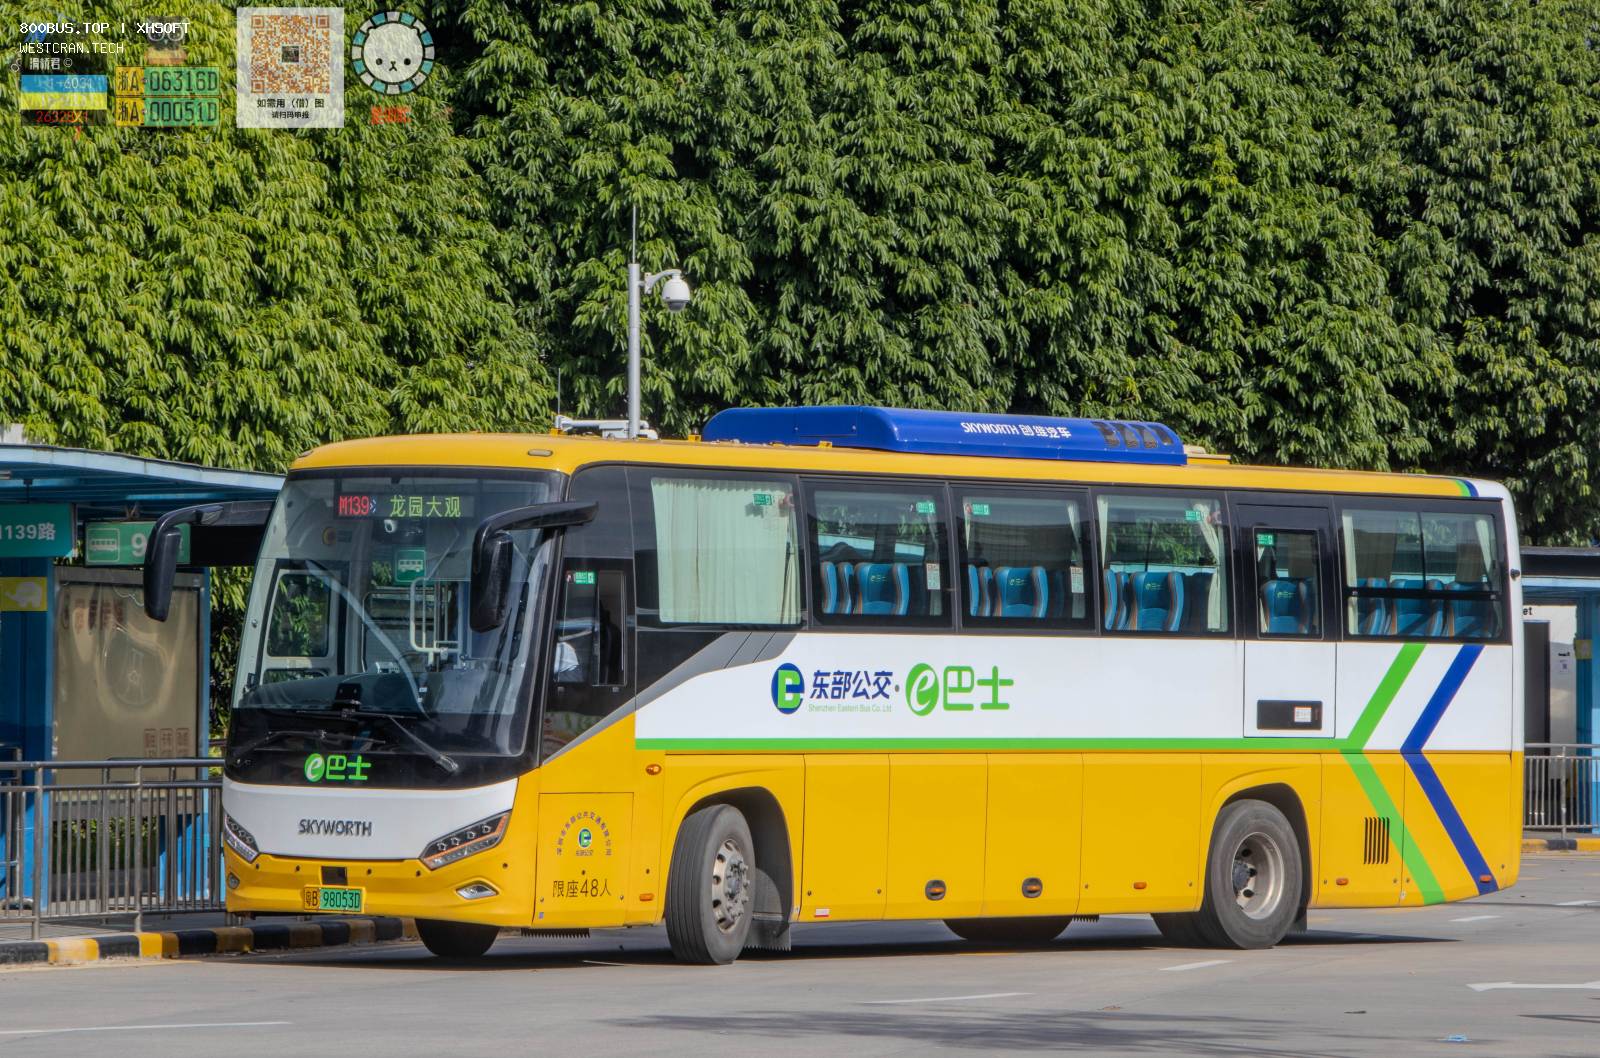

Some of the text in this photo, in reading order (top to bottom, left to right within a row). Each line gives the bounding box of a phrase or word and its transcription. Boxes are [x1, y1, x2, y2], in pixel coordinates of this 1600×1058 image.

[960, 422, 1020, 436] SKYWORTH
[338, 494, 462, 518] M139 龙园大观
[0, 522, 57, 541] 139路
[298, 818, 373, 837] SKYWORTH
[552, 878, 612, 899] 限座48人
